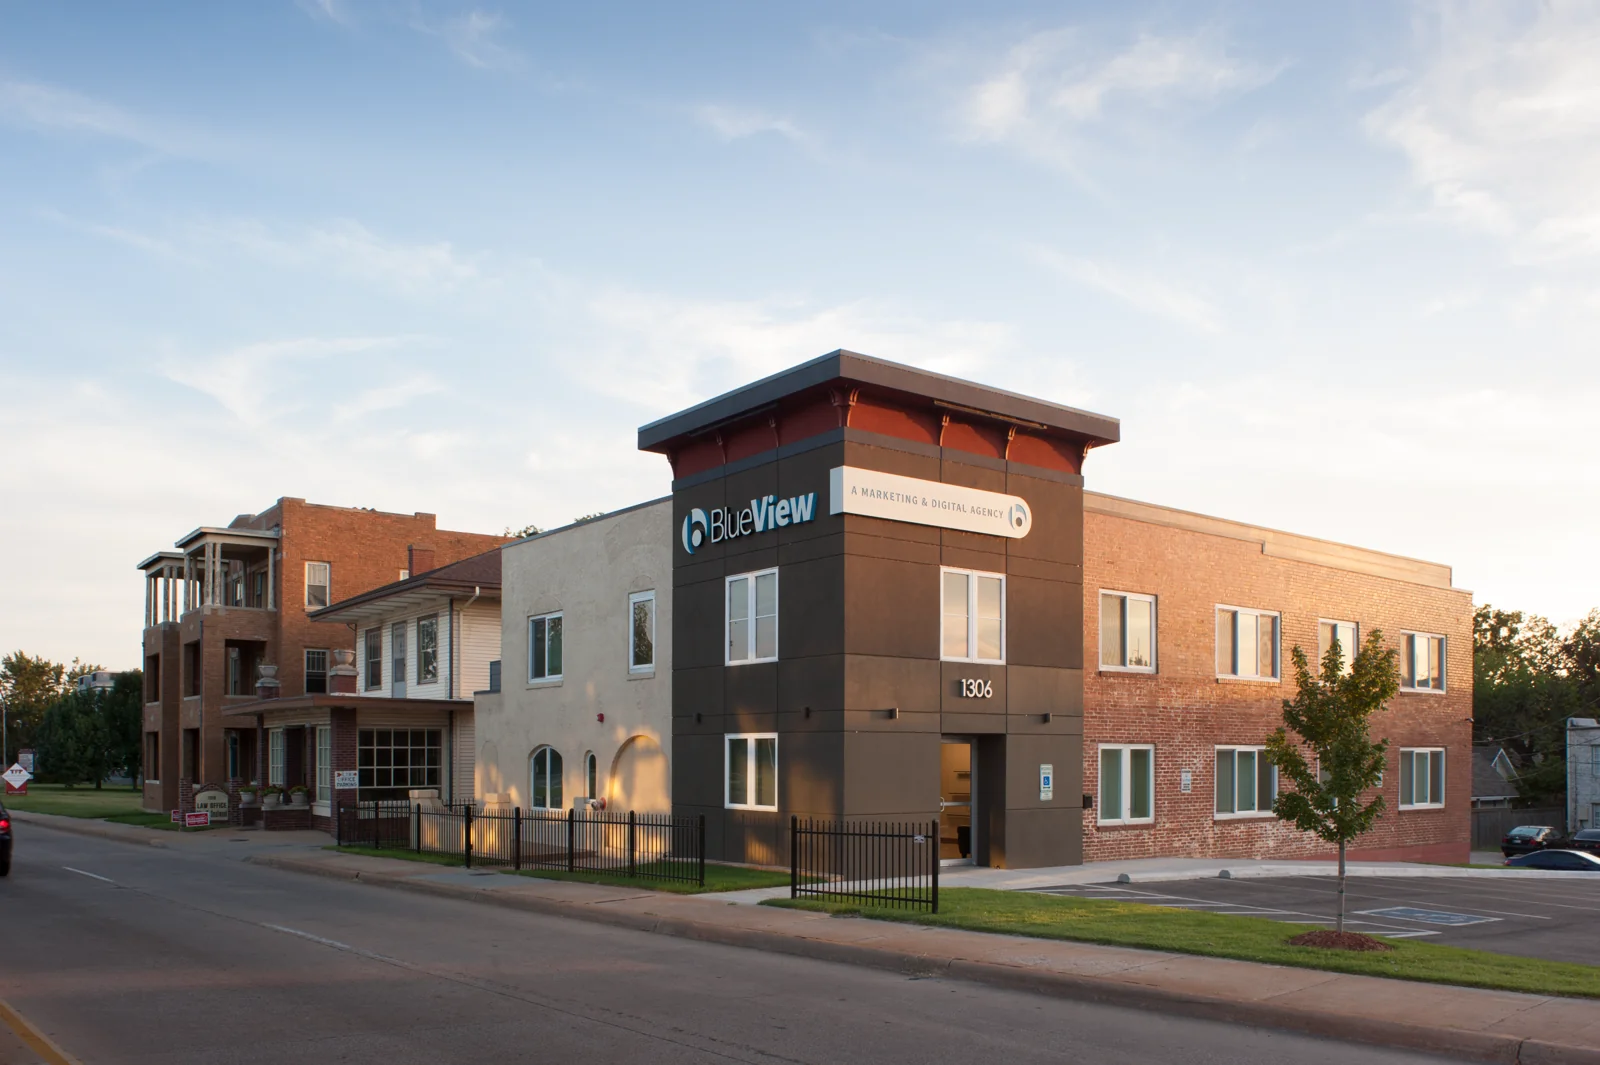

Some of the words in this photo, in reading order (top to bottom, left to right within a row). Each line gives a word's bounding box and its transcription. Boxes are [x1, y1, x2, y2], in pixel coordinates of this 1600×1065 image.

[711, 492, 817, 543] BlueView
[851, 485, 858, 496] A
[861, 487, 918, 505] MARKETING
[921, 497, 928, 507] &
[931, 499, 967, 513] DIGITAL
[970, 505, 1004, 519] AGENCY
[961, 678, 993, 698] 1306
